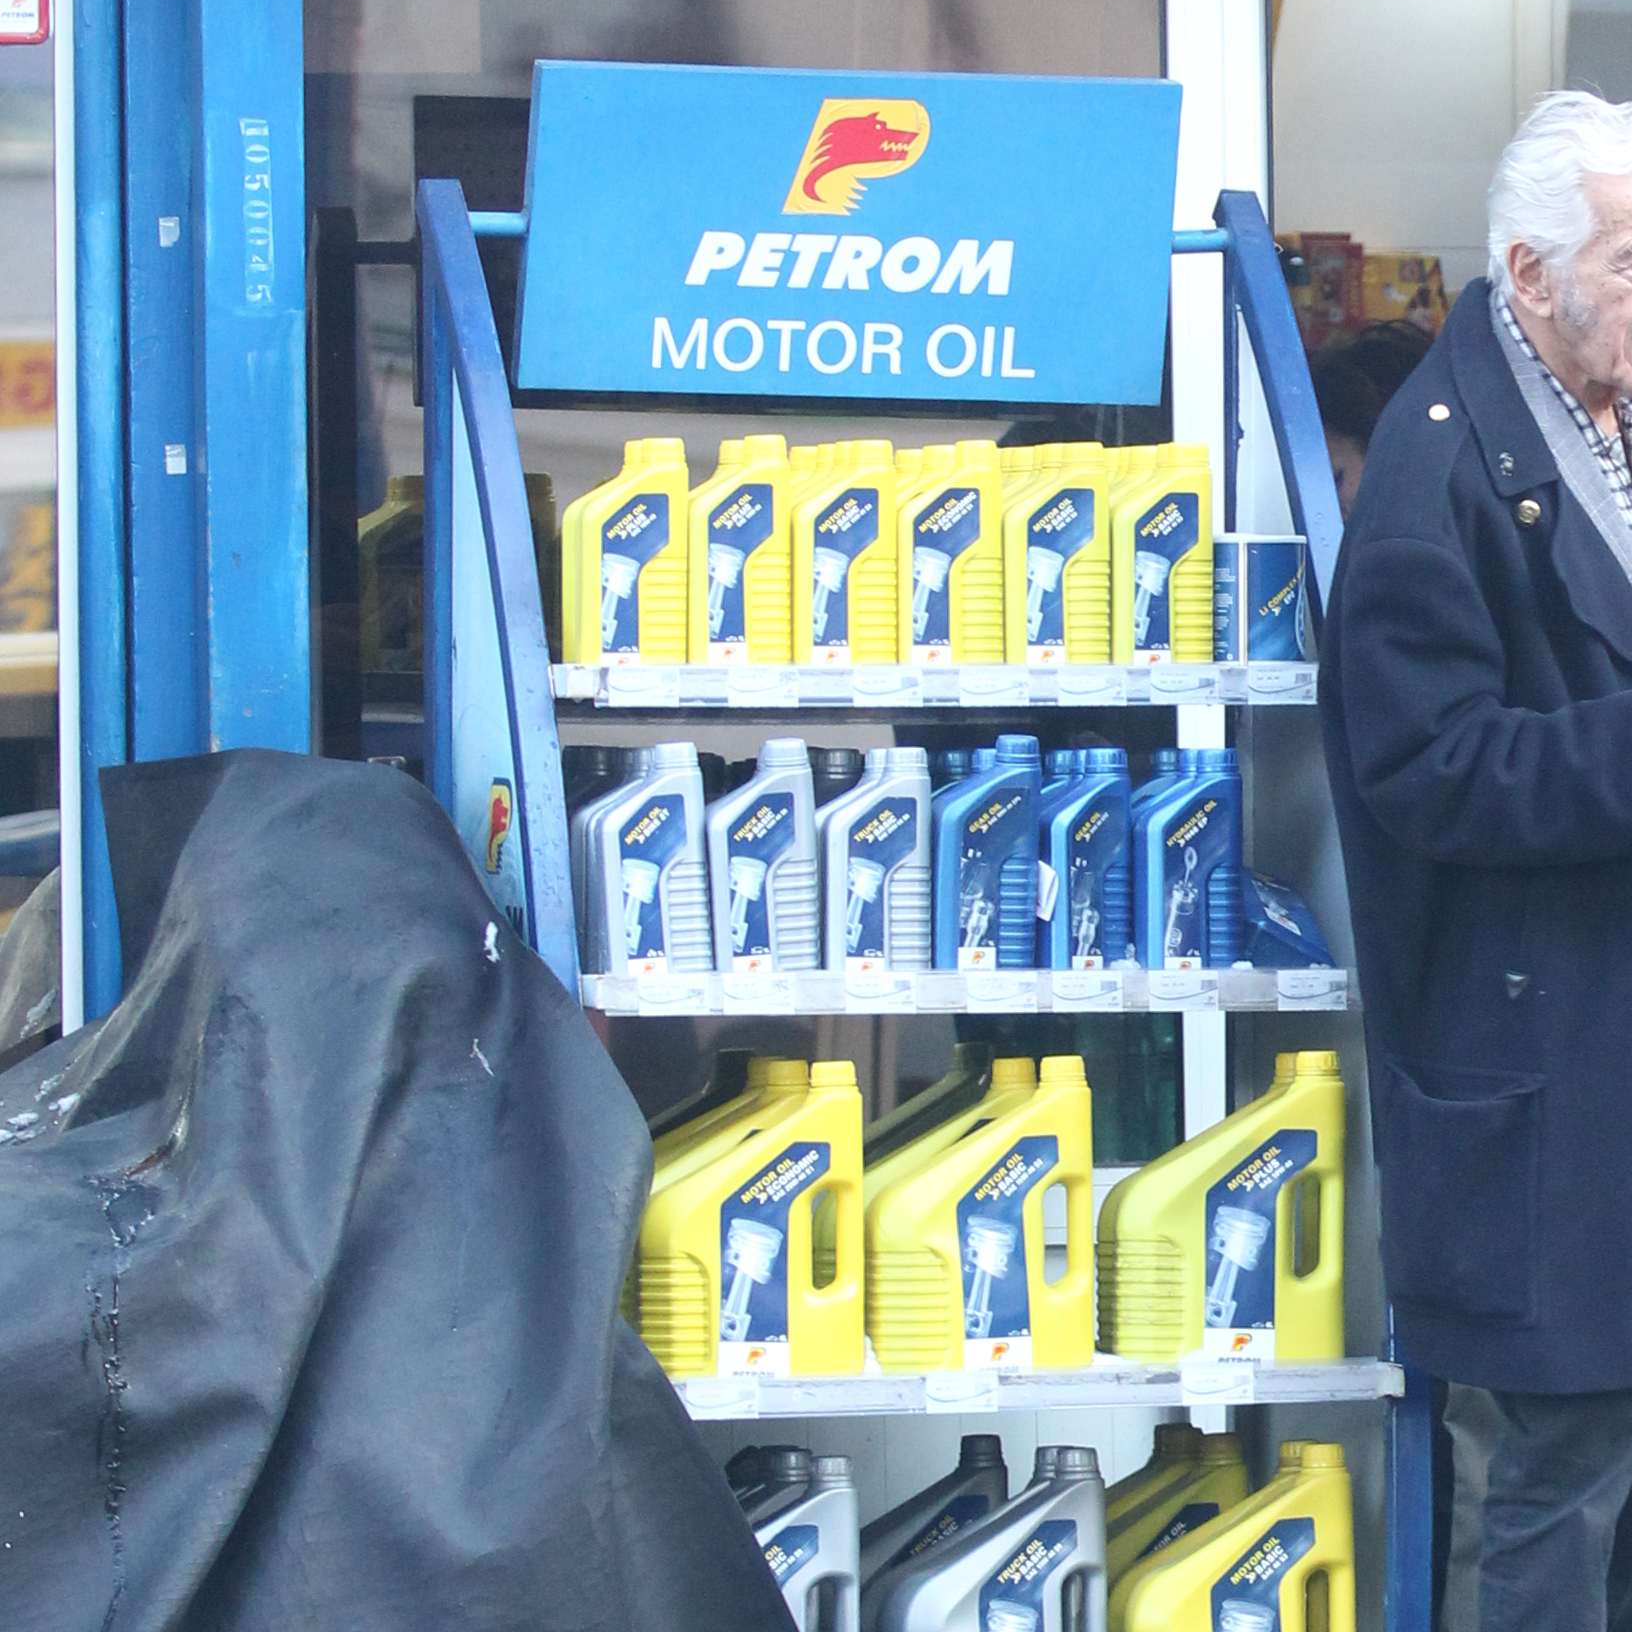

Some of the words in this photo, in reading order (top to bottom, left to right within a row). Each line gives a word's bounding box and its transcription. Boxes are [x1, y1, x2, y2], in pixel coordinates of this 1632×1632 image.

[684, 231, 1014, 296] PETROM
[650, 317, 904, 375] MOTOR
[925, 324, 1036, 379] OIL
[607, 513, 634, 539] MOTOR
[632, 503, 647, 515] OIL
[713, 504, 739, 529] MOTOR
[738, 494, 752, 506] OIL
[819, 508, 845, 533] MOTOR
[844, 498, 858, 510] OIL
[919, 508, 945, 533] MOTOR
[944, 498, 957, 510] OIL
[1032, 507, 1059, 533] MOTOR
[1058, 498, 1072, 510] OIL
[1140, 512, 1165, 537] MOTOR
[1164, 502, 1178, 514] OIL
[624, 817, 650, 845] MOTOR
[648, 806, 661, 819] OIL
[734, 816, 758, 841] TRUCK
[756, 805, 771, 818] OIL
[854, 818, 879, 842] TRUCK
[878, 809, 893, 821] OIL
[1166, 810, 1205, 847] HYDRAULIC
[1203, 800, 1217, 812] OIL
[740, 1170, 778, 1204] MOTOR
[776, 1157, 795, 1174] OIL
[766, 1149, 820, 1196] ECONOMIC
[974, 1167, 1008, 1201] MOTOR
[1006, 1153, 1024, 1170] OIL
[997, 1162, 1027, 1192] BASIC
[1226, 1159, 1263, 1191] MOTOR
[1262, 1146, 1281, 1162] OIL
[1252, 1158, 1280, 1183] PLUS
[764, 1545, 783, 1561] OIL
[768, 1551, 787, 1570] SIC
[996, 1552, 1027, 1584] TRUCK
[1026, 1539, 1043, 1555] OIL
[1019, 1545, 1047, 1576] BASIC
[1230, 1550, 1264, 1585] MOTOR
[1262, 1536, 1281, 1552] OIL
[1254, 1545, 1284, 1575] BASIC
